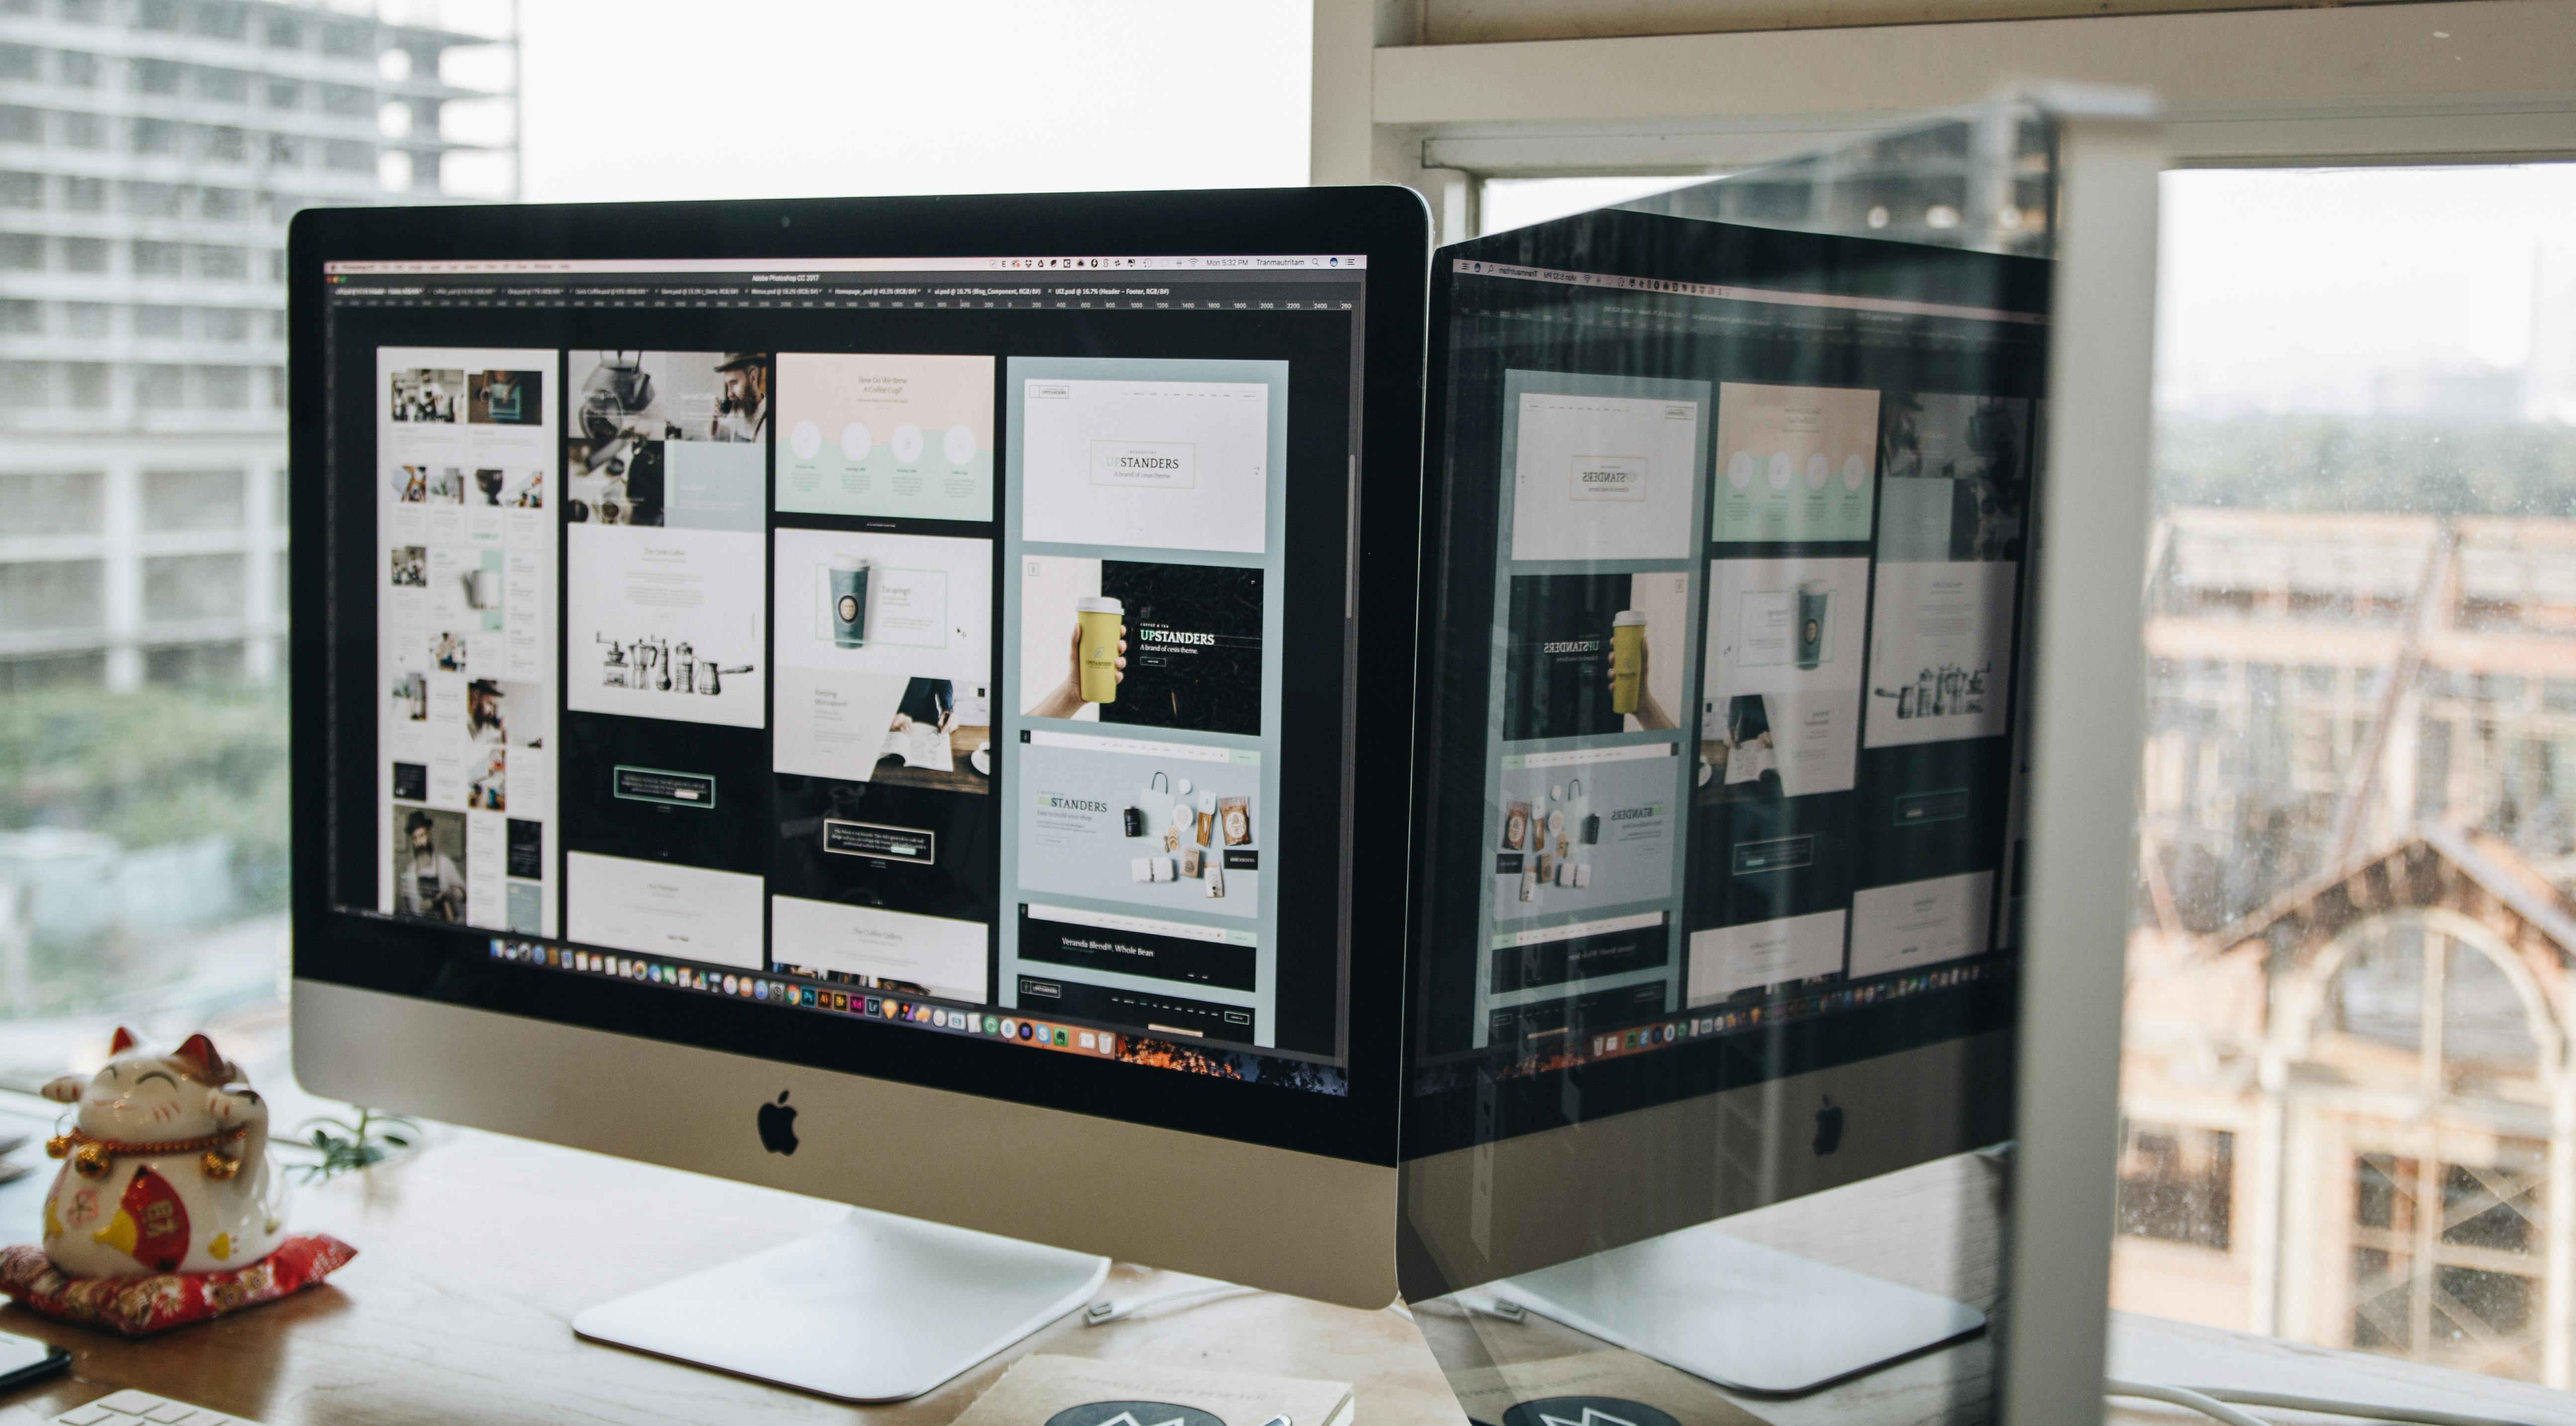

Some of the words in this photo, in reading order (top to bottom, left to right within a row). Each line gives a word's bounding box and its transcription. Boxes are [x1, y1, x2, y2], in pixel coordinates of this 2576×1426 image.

[887, 386, 902, 396] Cup?
[1106, 456, 1179, 469] UPSTANDERS
[1140, 629, 1215, 645] UPSTANDERS
[864, 929, 882, 938] Coffee
[883, 933, 903, 942] Gallery
[1062, 937, 1087, 948] Veranda
[1115, 945, 1136, 954] Whole
[1137, 948, 1154, 957] Bean
[821, 994, 829, 1003] Ai
[851, 999, 862, 1009] Xd
[868, 1002, 878, 1012] Lr
